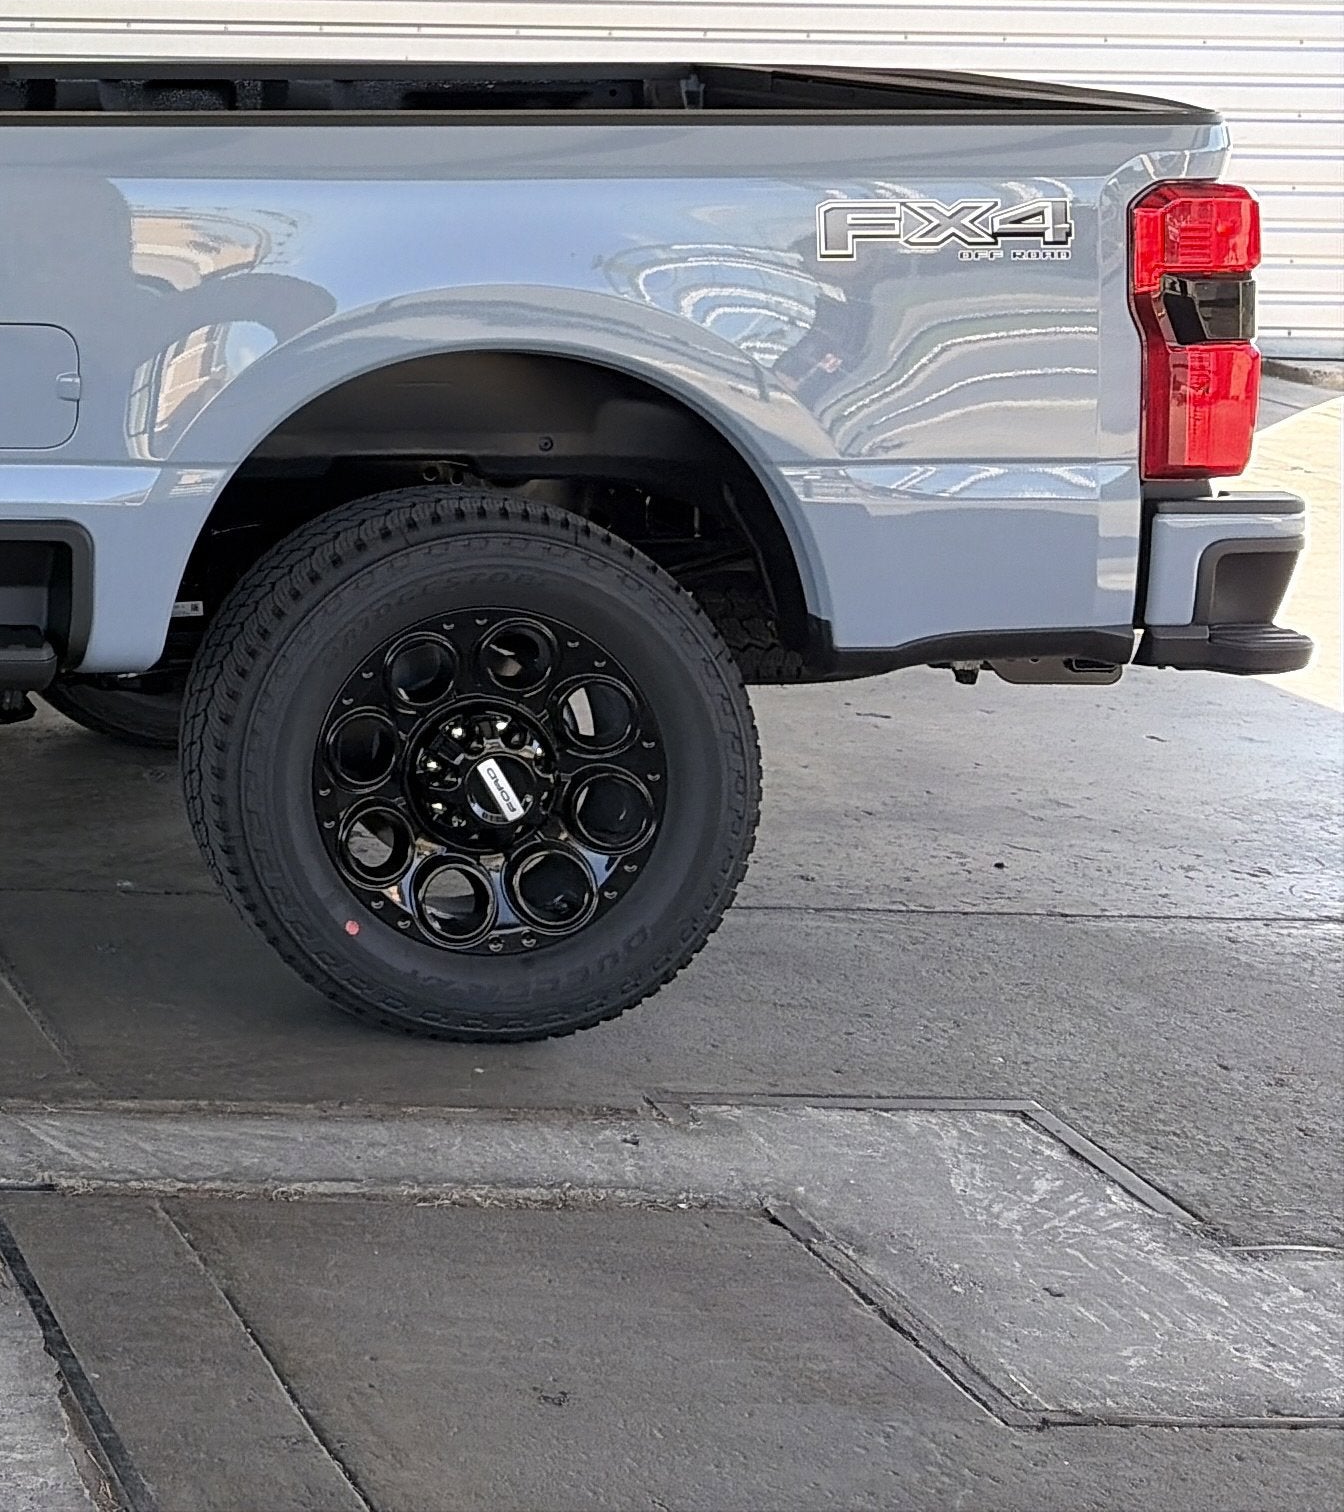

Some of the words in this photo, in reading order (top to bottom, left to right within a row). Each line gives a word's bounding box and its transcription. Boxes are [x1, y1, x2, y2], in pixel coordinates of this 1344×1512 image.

[816, 198, 1074, 261] FX4
[958, 249, 1004, 261] OFF
[1011, 249, 1072, 261] ROAD
[486, 767, 517, 813] FORD
